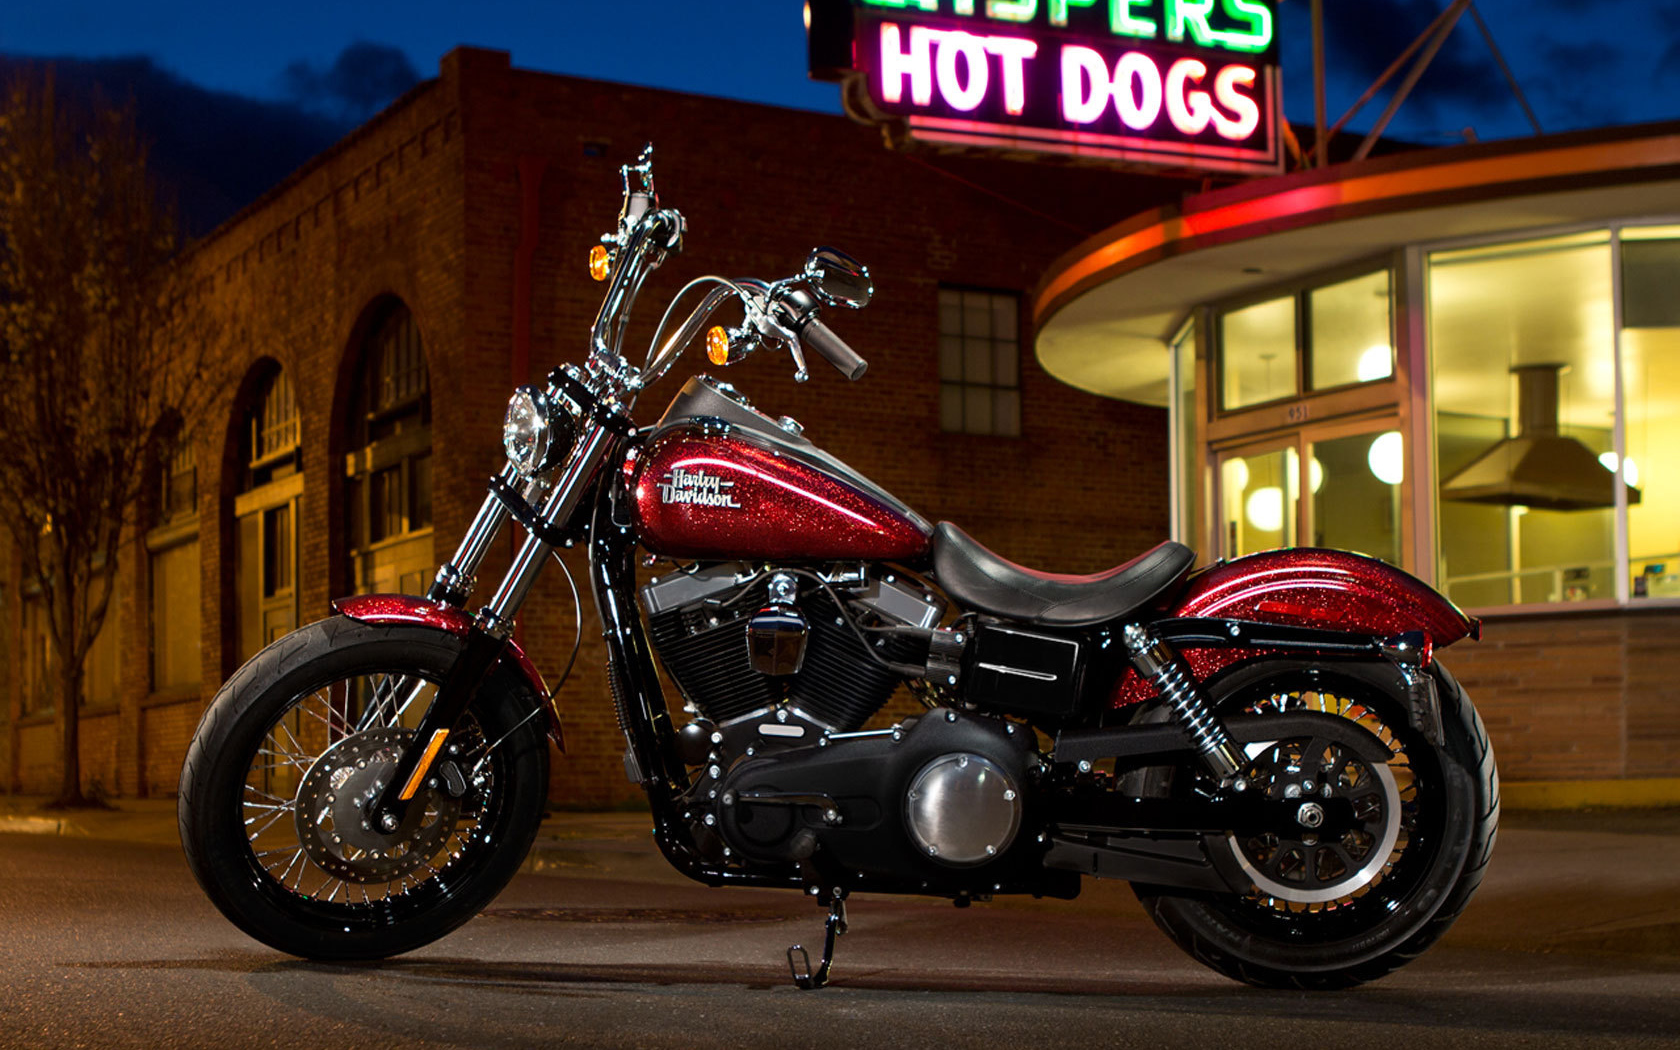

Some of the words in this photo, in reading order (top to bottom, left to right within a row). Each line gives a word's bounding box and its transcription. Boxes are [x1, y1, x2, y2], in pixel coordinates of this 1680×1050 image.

[880, 22, 1038, 115] HOT
[1060, 44, 1260, 140] DOGS
[656, 482, 741, 508] Davidson
